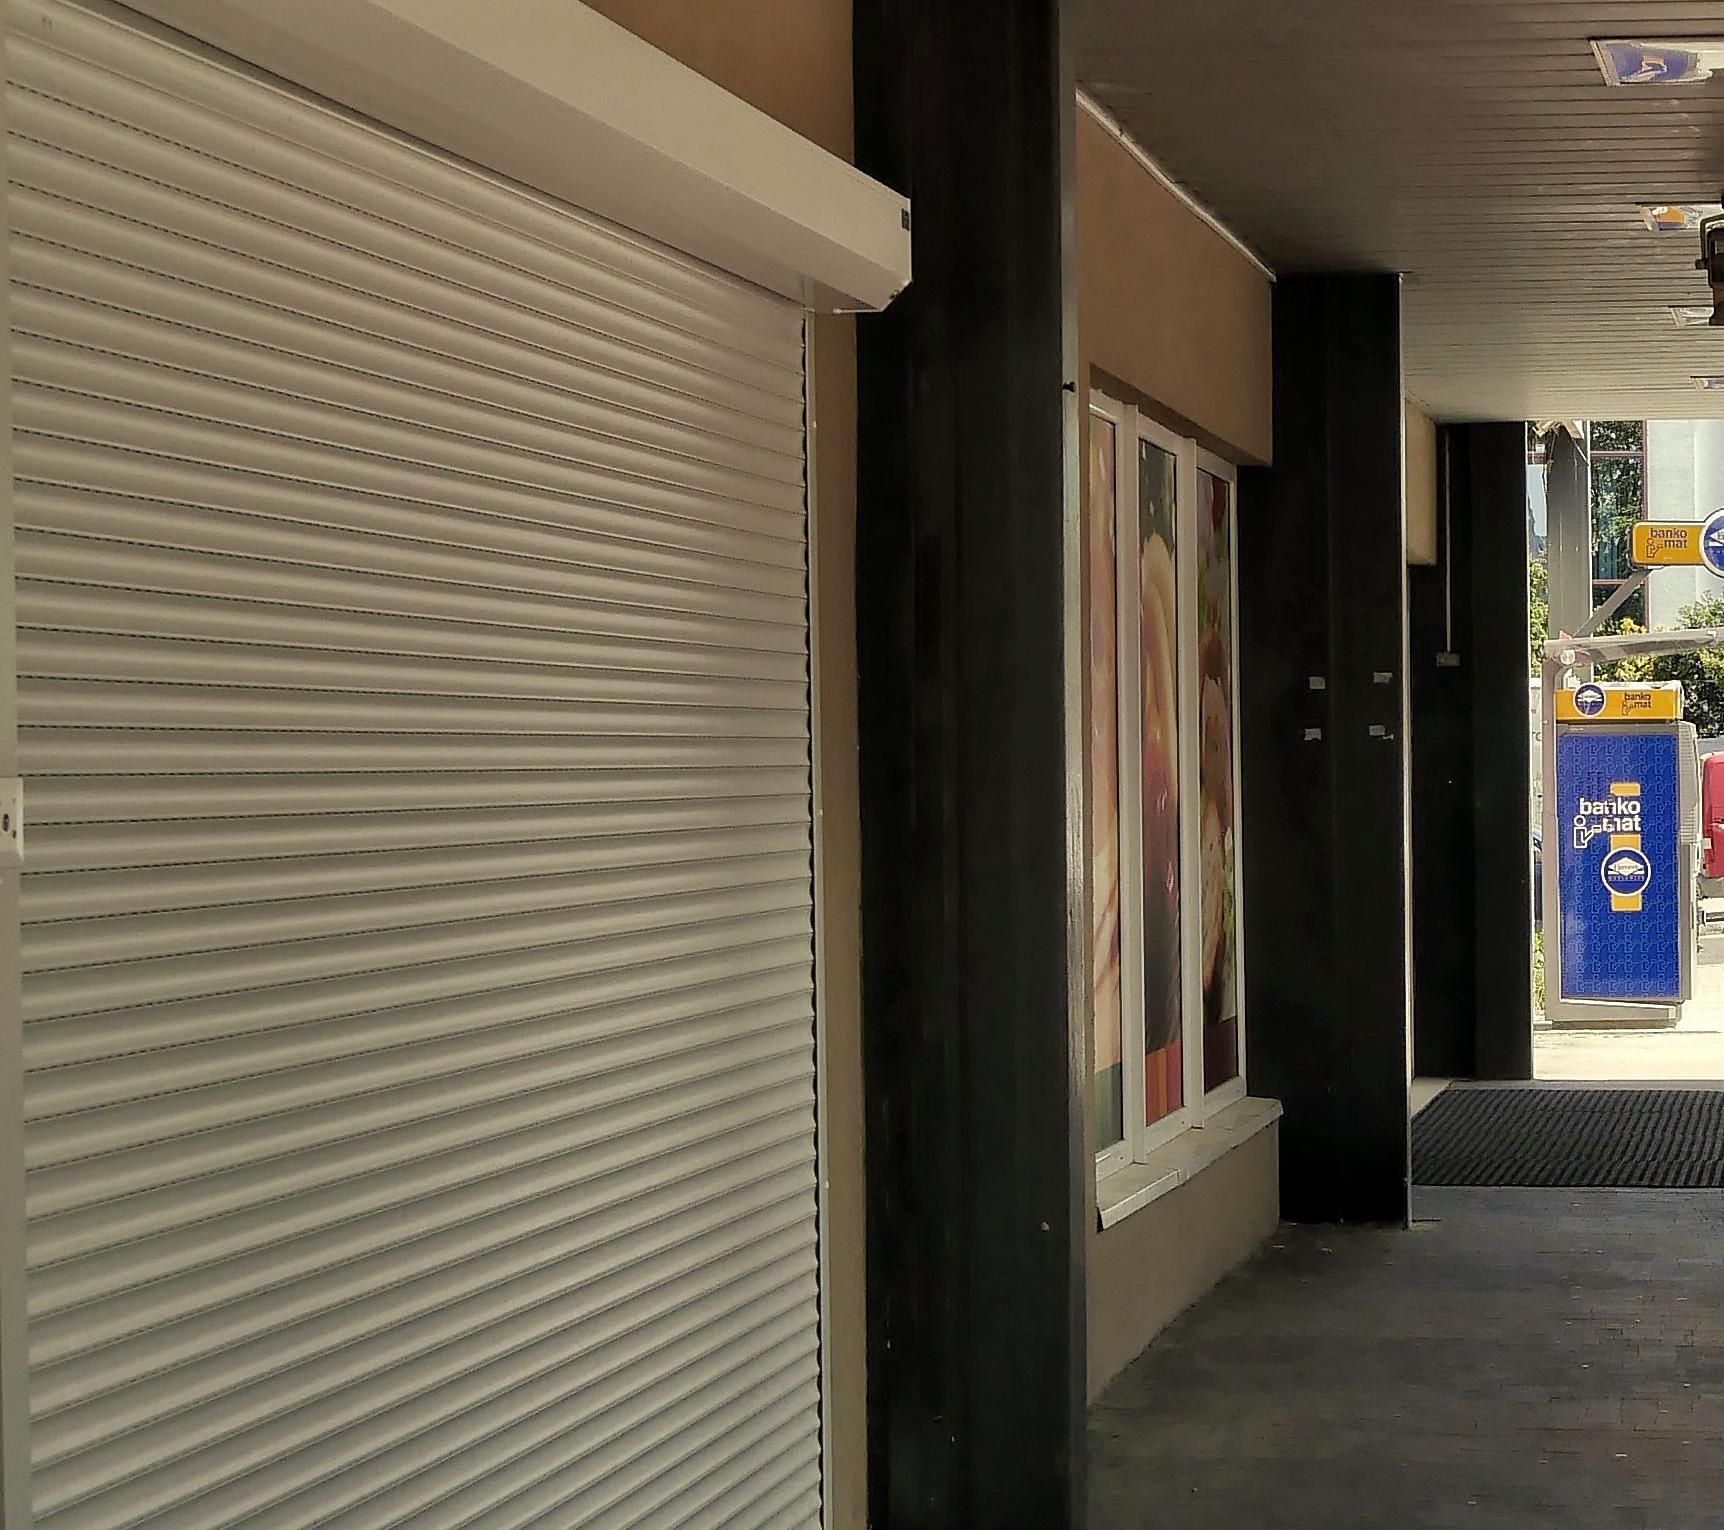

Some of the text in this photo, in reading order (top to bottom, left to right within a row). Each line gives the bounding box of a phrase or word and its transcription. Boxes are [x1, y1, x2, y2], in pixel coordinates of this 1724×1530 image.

[1650, 527, 1688, 539] banko
[1663, 538, 1688, 549] mat
[1624, 692, 1652, 701] banko
[1580, 797, 1641, 815] banko
[1602, 814, 1642, 832] mat
